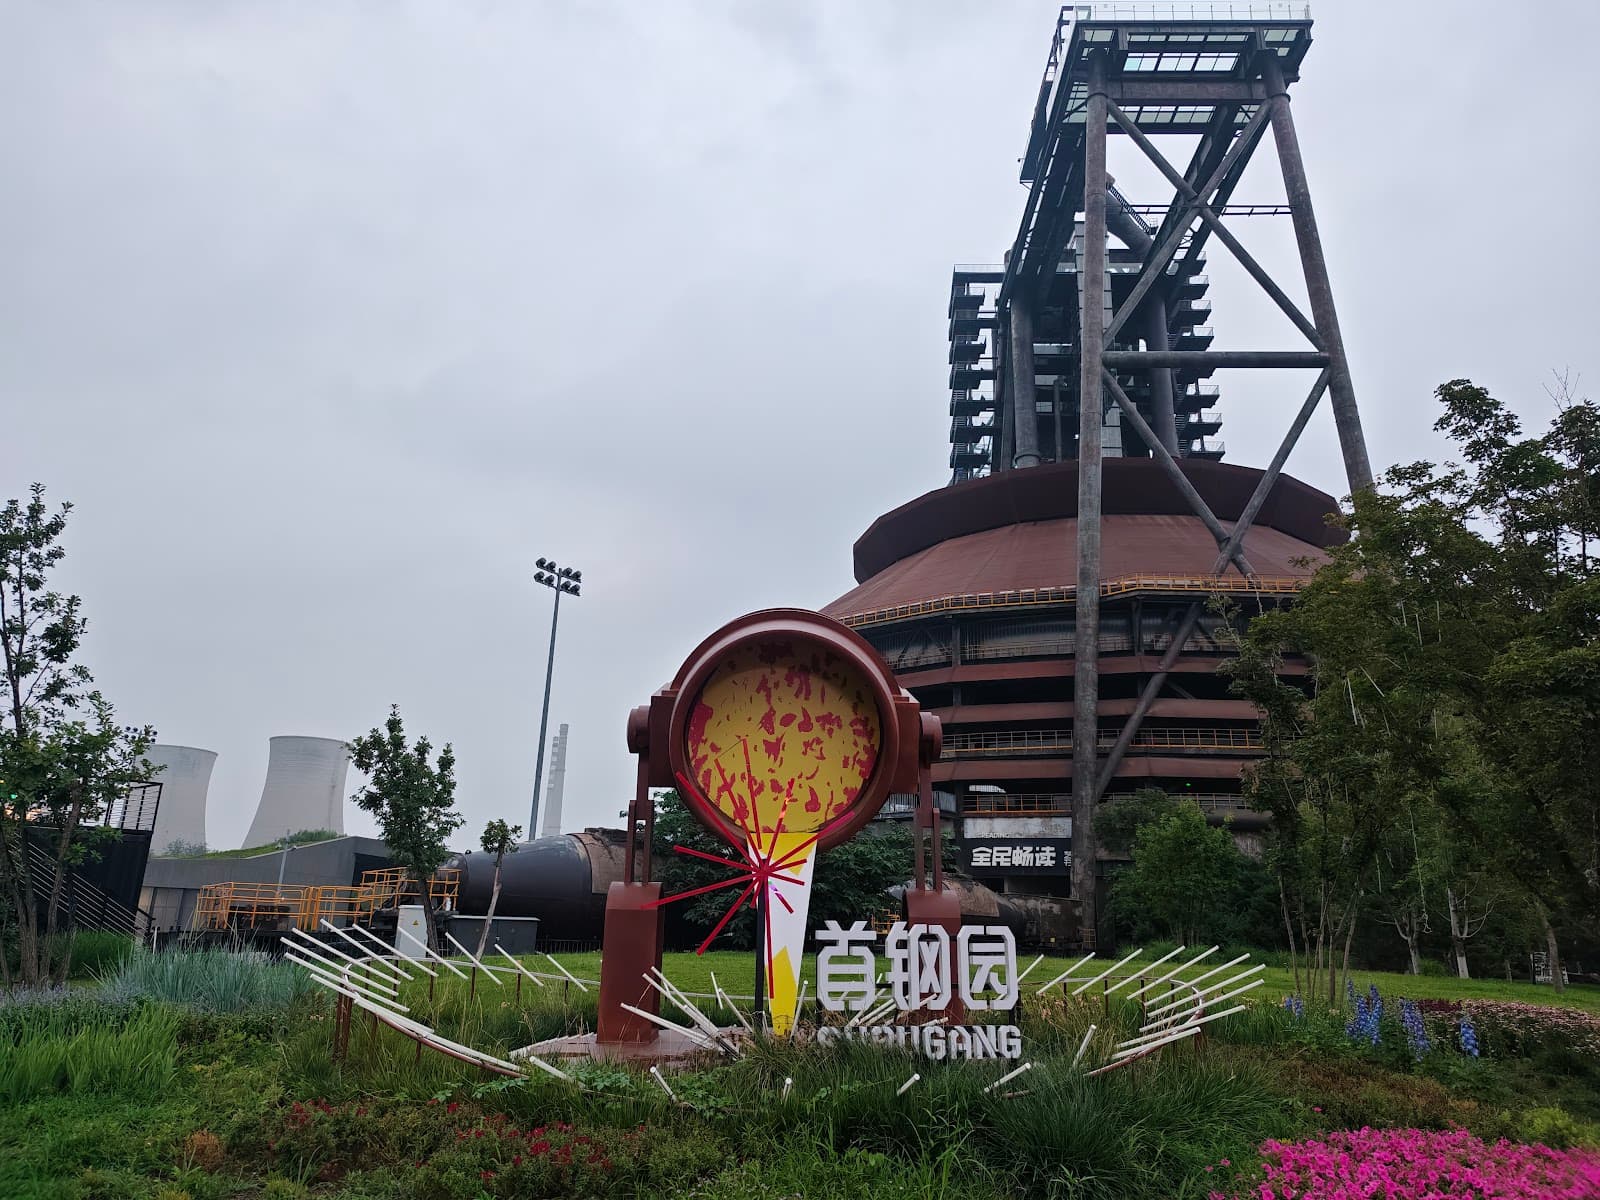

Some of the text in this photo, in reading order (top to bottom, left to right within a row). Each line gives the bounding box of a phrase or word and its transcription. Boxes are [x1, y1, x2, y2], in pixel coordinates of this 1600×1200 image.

[971, 846, 1056, 867] 全民畅读
[815, 920, 1019, 1010] 首钢园
